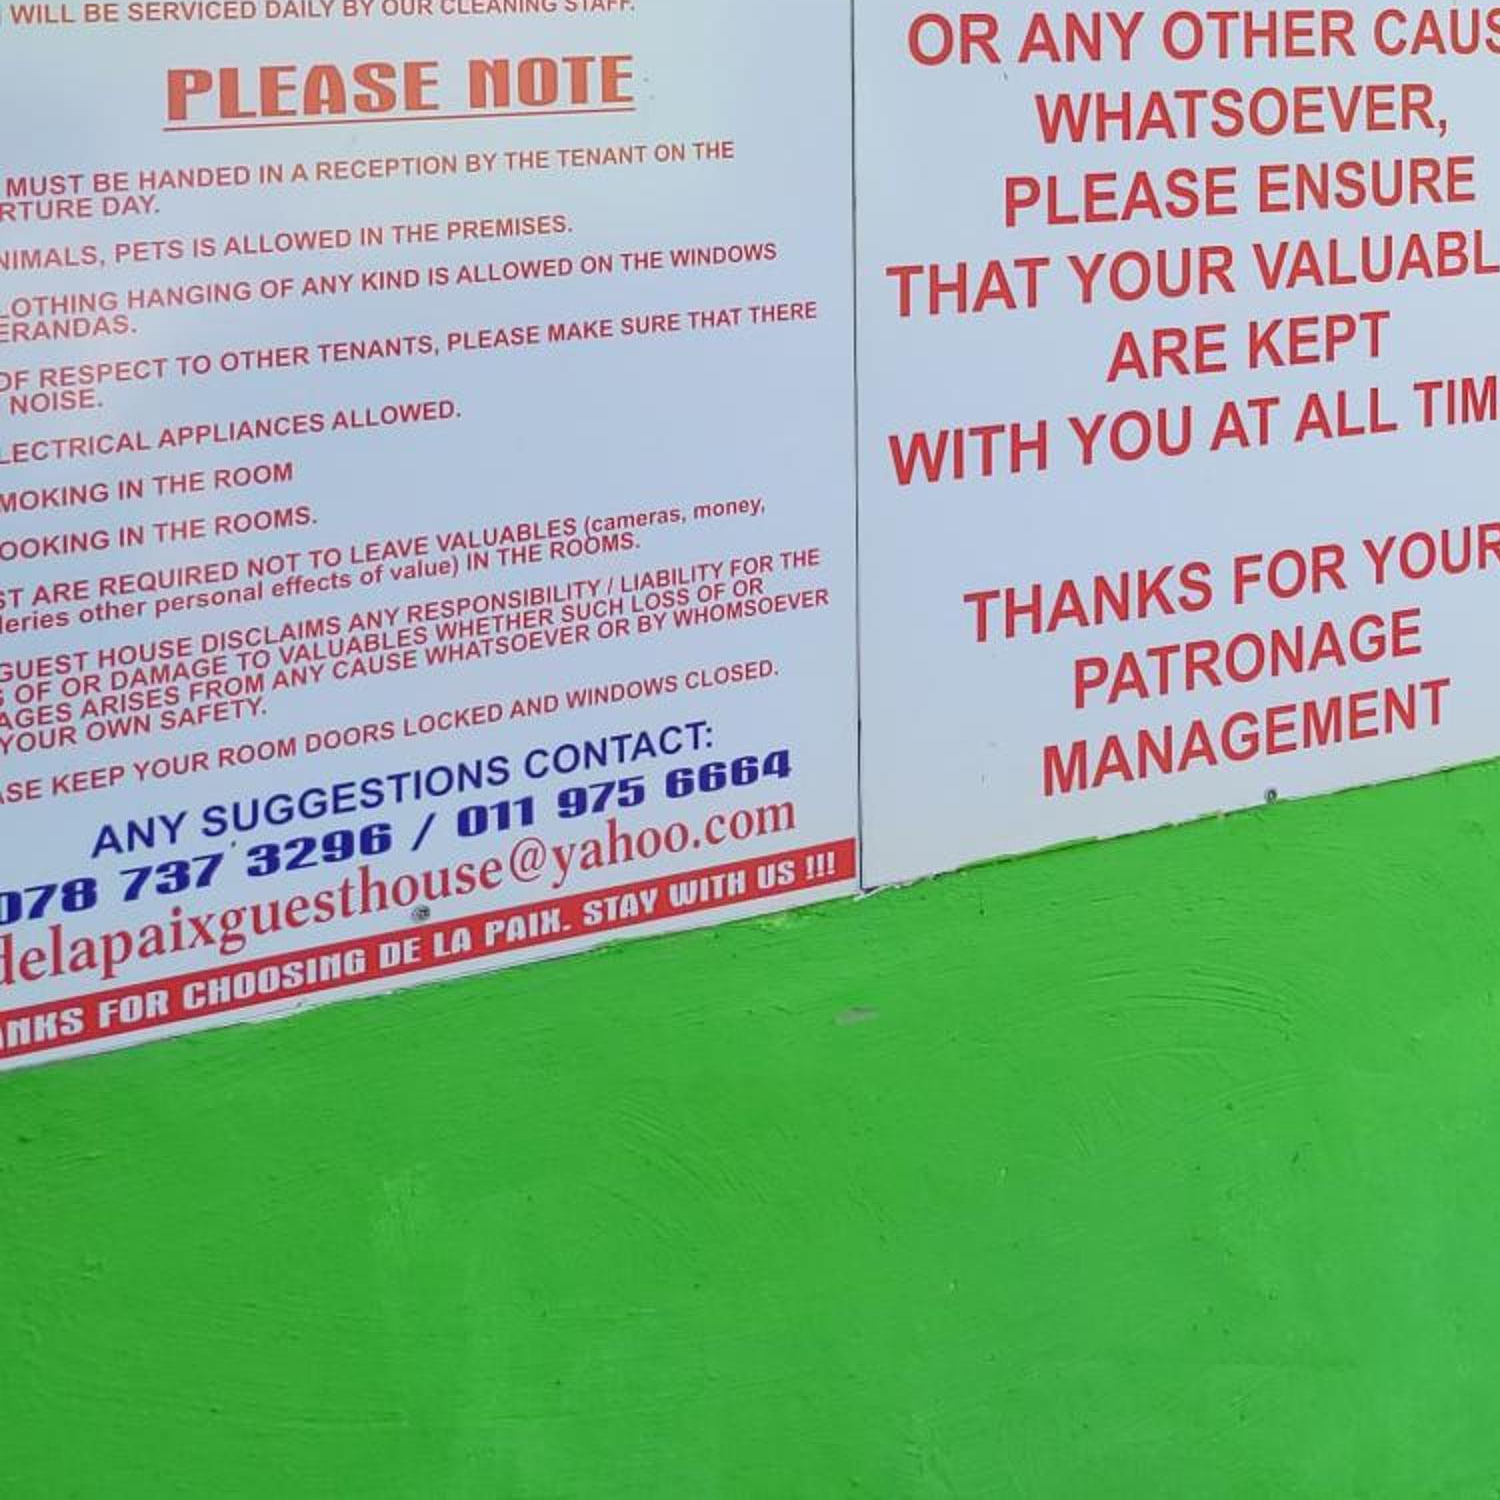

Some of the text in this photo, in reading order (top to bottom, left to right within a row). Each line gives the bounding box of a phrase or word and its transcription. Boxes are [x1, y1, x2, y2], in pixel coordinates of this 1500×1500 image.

[906, 12, 1003, 67] OR
[1016, 10, 1146, 65] ANY
[1161, 8, 1358, 62] OTHER
[166, 53, 635, 122] PLEASE NOTE
[1033, 82, 1448, 145] WHATSOEVER,
[5, 140, 735, 199] MUST BE HANDED IN A RECEPTION BY THE TENANT ON THE
[1004, 154, 1477, 229] PLEASE ENSURE
[114, 214, 573, 264] PETS IS ALLOWED IN THE PREMISES.
[884, 255, 1052, 319] THAT
[1065, 244, 1237, 306] YOUR
[1105, 309, 1392, 384] ARE KEPT
[156, 399, 462, 450] APPLIANCES ALLOWED.
[886, 418, 1049, 487] WITH
[1065, 403, 1193, 467] YOU
[1208, 395, 1282, 453] AT
[1293, 386, 1400, 444] ALL
[962, 560, 1214, 644] THANKS
[1232, 542, 1349, 606] FOR
[1073, 606, 1424, 710] PATRONAGE
[0, 694, 268, 757] YOUR OWN SAFETY.
[51, 658, 780, 797] KEEP YOUR ROOM DOORS LOCKED AND WINDOWS CLOSED.
[1042, 676, 1452, 798] MANAGEMENT
[89, 720, 712, 860] ANY SUGGESTIONS CONTACT:
[118, 851, 225, 903] 737
[245, 821, 394, 878] 3296
[456, 794, 535, 839] 011
[556, 774, 647, 820] 975
[664, 748, 792, 800] 6664
[98, 989, 169, 1029] FOR
[183, 948, 366, 1010] CHOOSING
[379, 937, 421, 969] DE
[433, 927, 471, 958] LA
[484, 908, 571, 947] PAIX.
[582, 887, 658, 926] STAY
[668, 869, 746, 908] WITH
[757, 860, 796, 890] US
